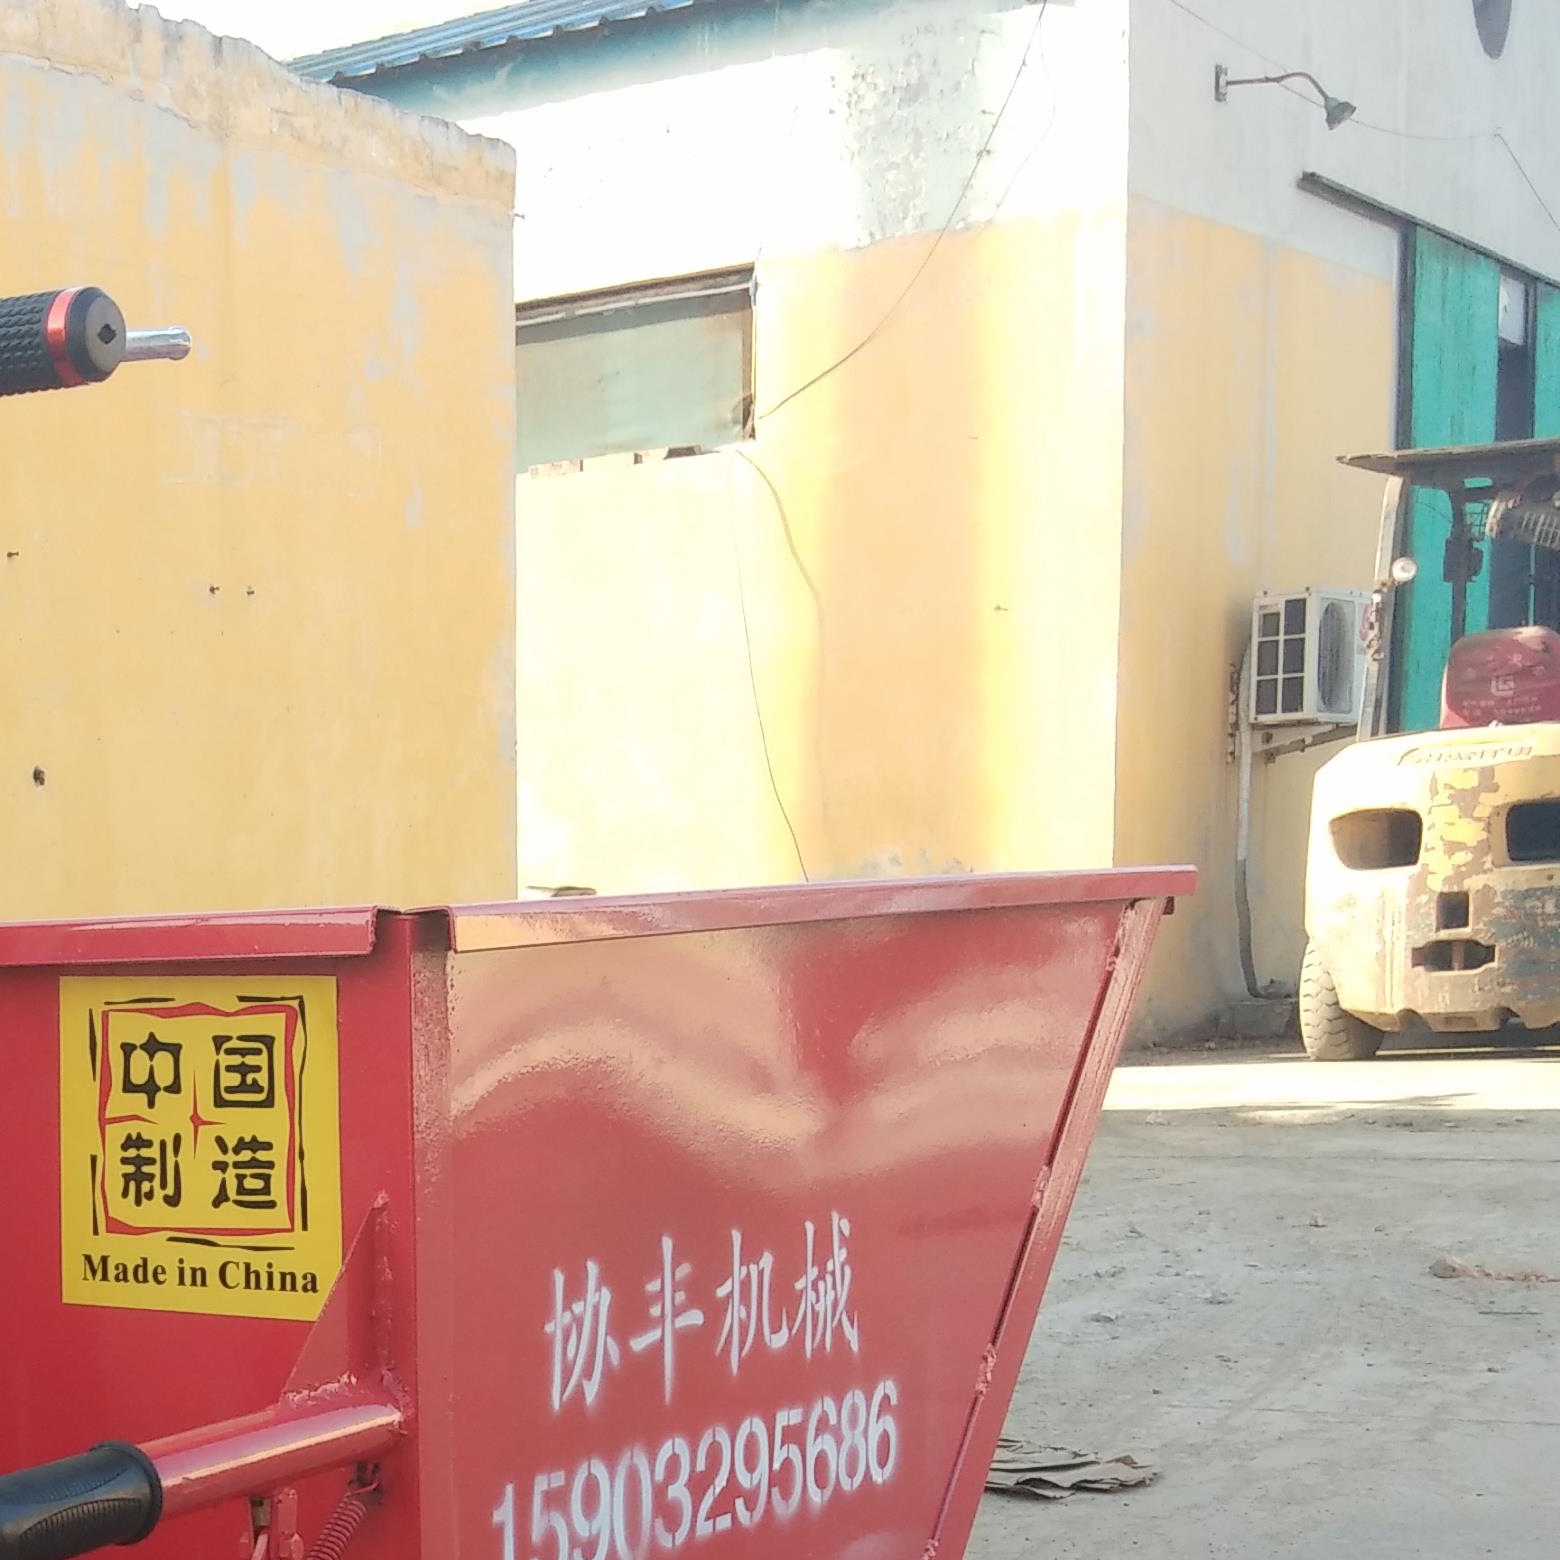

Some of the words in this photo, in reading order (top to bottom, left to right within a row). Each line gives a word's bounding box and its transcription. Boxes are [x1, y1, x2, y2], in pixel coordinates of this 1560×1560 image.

[120, 1031, 276, 1109] 中国
[120, 1132, 278, 1209] 制造
[82, 1253, 167, 1284] Made
[177, 1258, 208, 1288] in
[218, 1261, 319, 1293] China
[544, 1211, 861, 1411] 协丰机械
